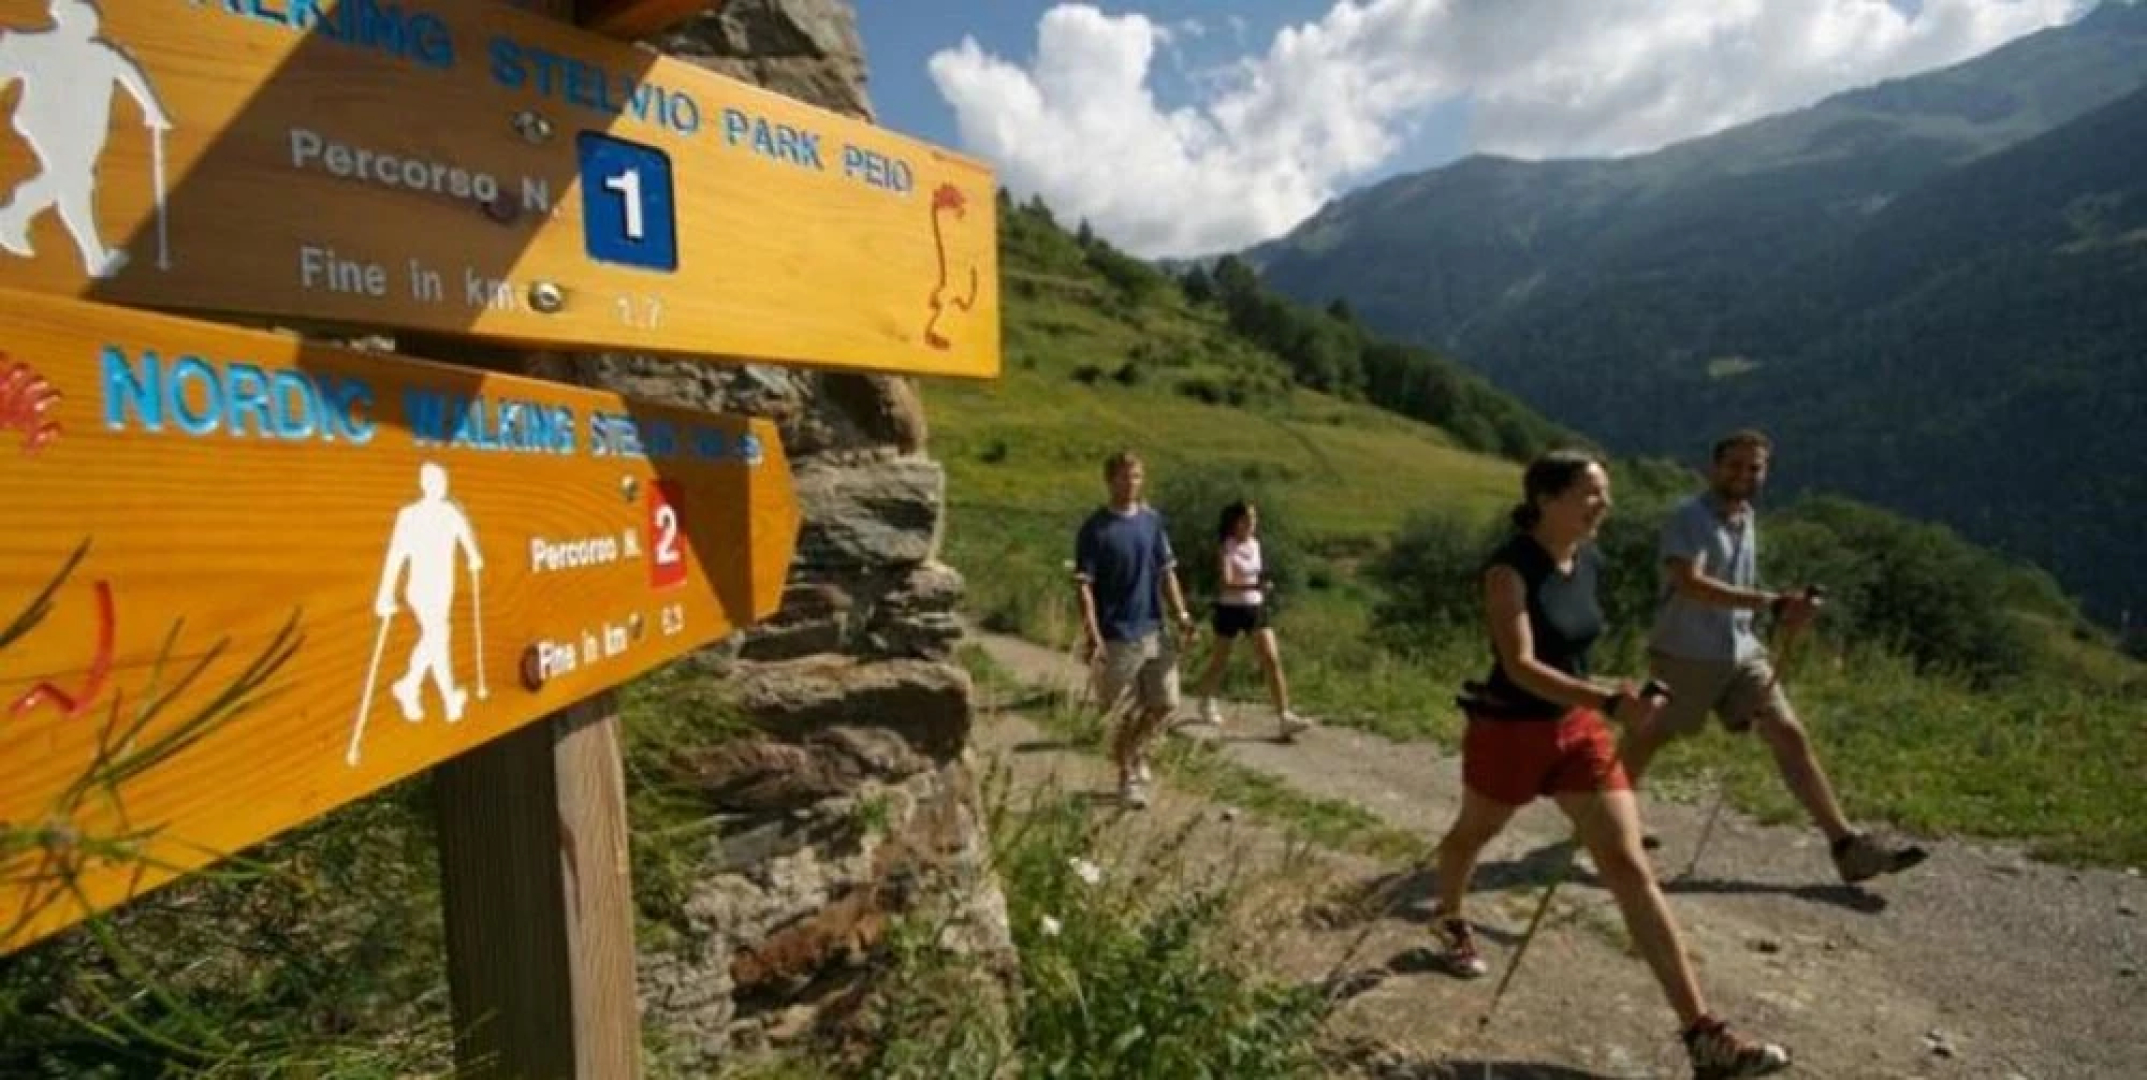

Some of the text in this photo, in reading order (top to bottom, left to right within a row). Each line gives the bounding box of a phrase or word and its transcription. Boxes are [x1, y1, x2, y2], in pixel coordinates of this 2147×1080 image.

[490, 37, 698, 133] STELVIO
[724, 107, 824, 172] PARK
[844, 144, 914, 194] PEIO
[290, 128, 498, 201] Percorso
[605, 166, 644, 240] 1
[300, 245, 387, 296] Fine
[410, 258, 442, 301] in
[102, 347, 376, 443] NORDIC
[403, 389, 574, 454] WALKING
[530, 534, 618, 573] Percorso
[654, 504, 681, 565] 2
[538, 639, 577, 679] Fine
